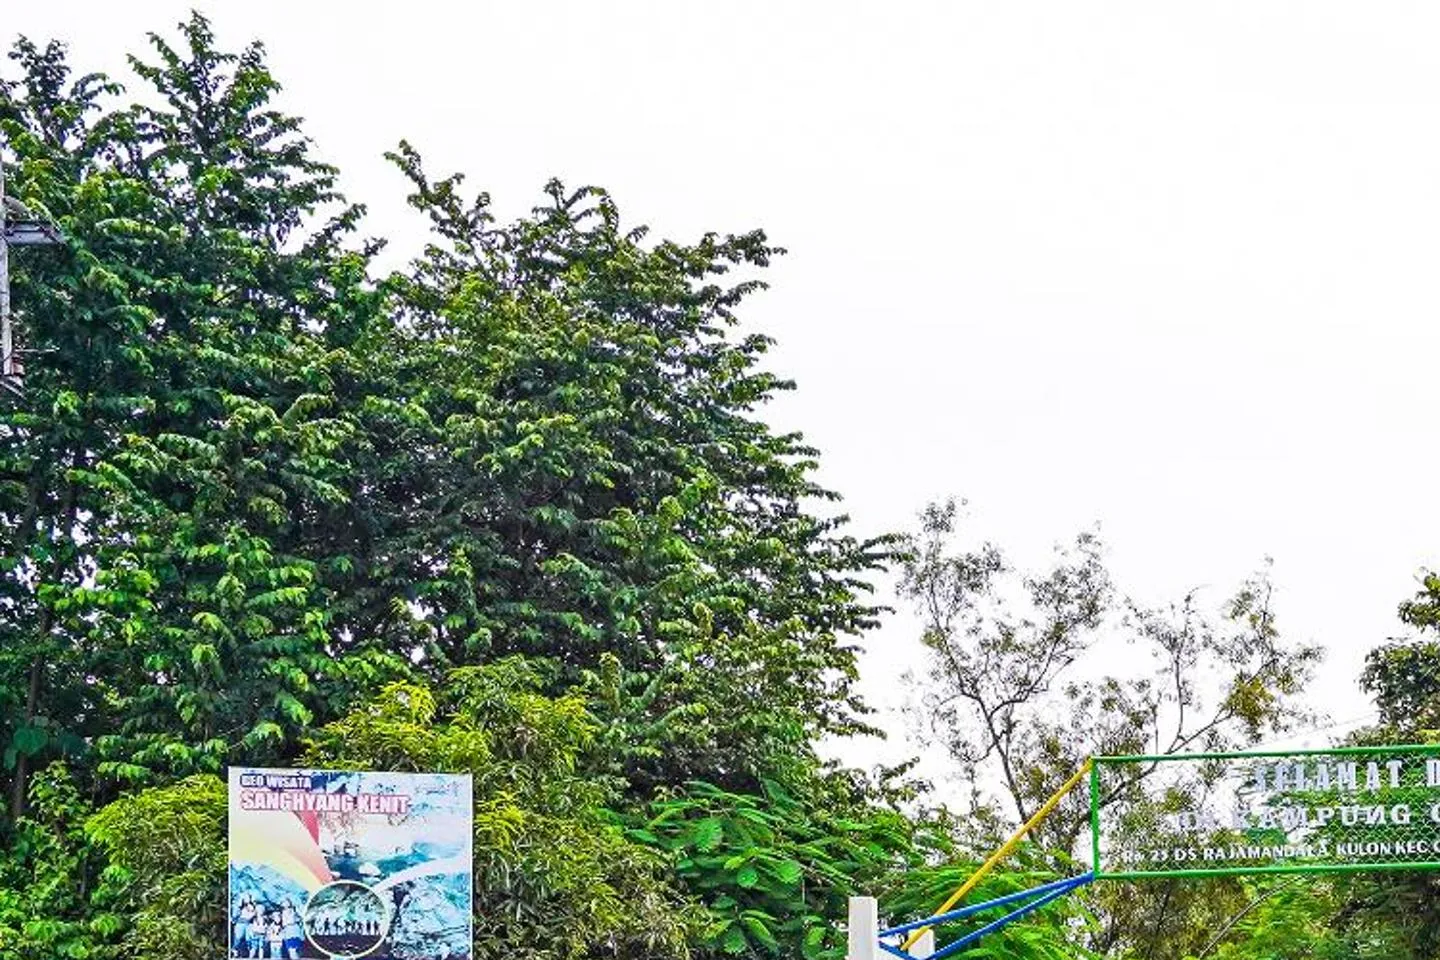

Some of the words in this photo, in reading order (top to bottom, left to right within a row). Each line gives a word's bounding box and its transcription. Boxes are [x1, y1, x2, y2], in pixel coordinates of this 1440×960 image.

[266, 775, 312, 790] WISATA
[241, 790, 355, 813] SANGHYANG
[357, 794, 411, 816] KENIT
[1174, 847, 1197, 861] DS
[1202, 840, 1329, 861] RAJAMANDALA
[1336, 840, 1391, 856] KULON
[1395, 840, 1429, 855] KEC
